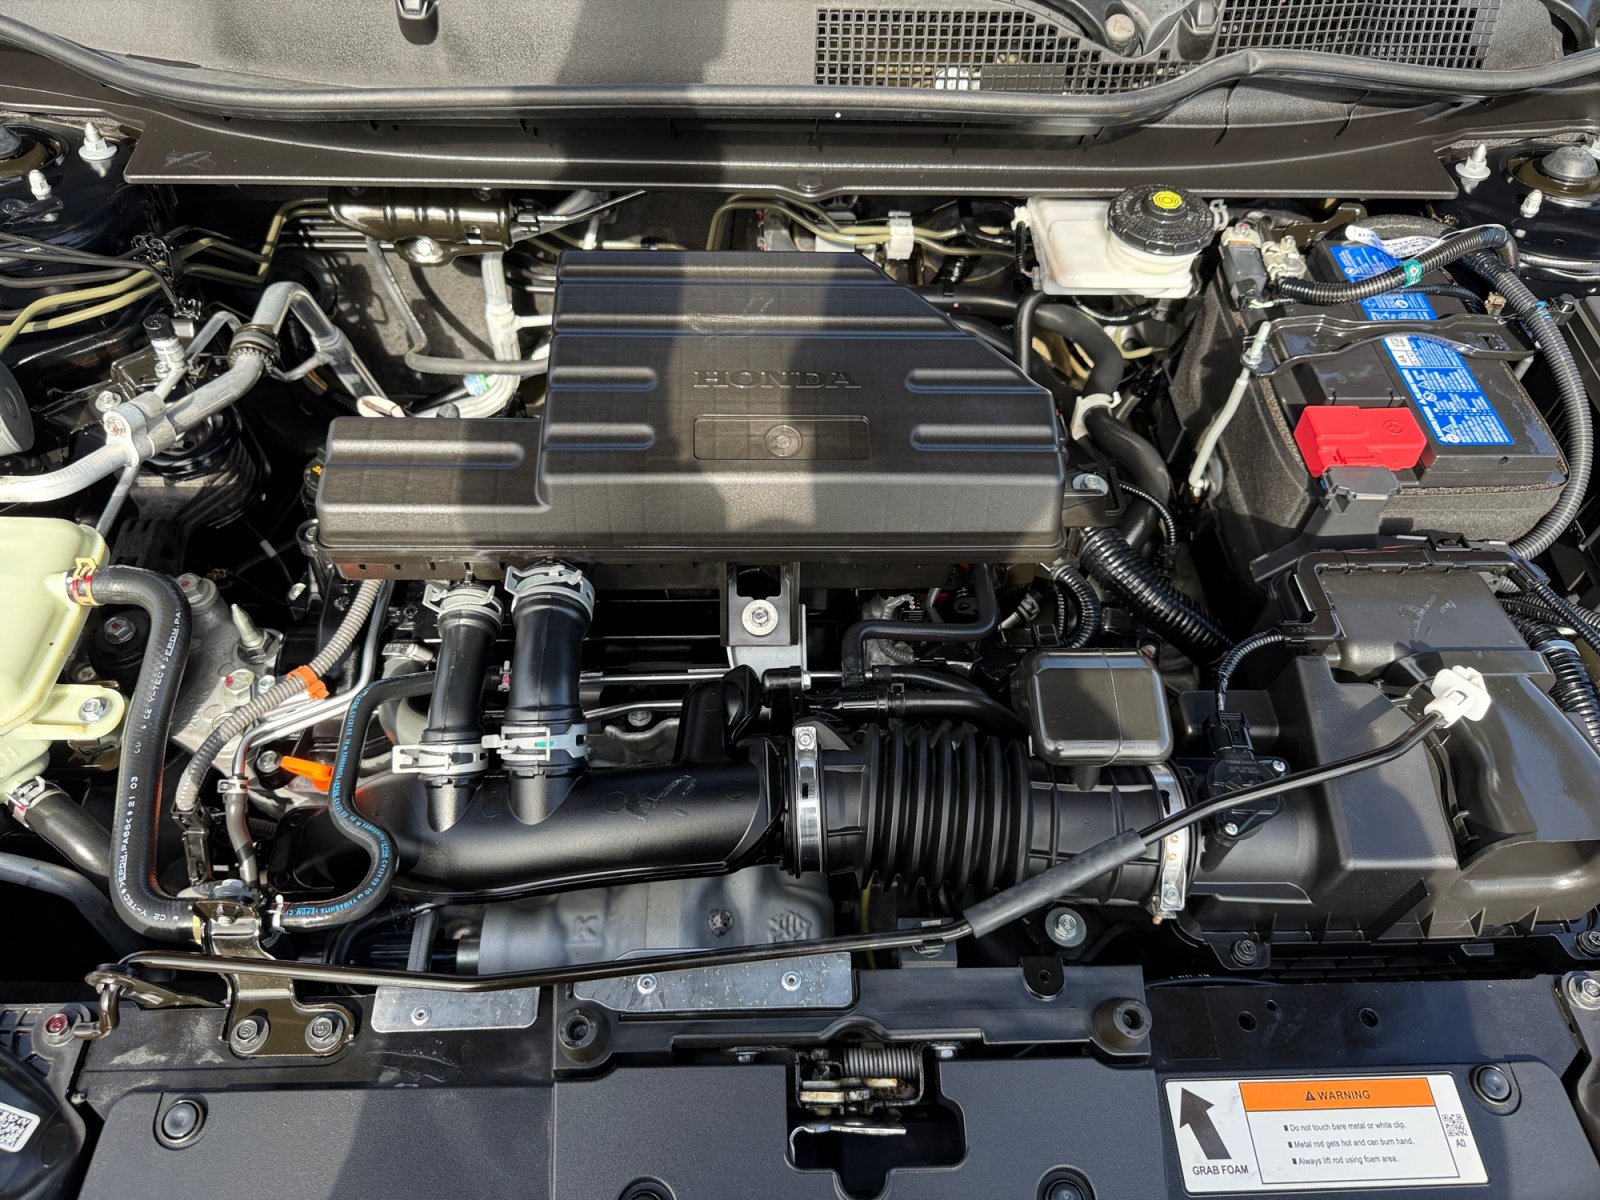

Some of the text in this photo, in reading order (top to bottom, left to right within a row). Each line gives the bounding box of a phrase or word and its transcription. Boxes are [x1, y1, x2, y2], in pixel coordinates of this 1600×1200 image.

[693, 369, 862, 389] HONDA
[320, 898, 358, 914] YAMASHITA
[1317, 1090, 1371, 1100] WARNING
[1290, 1121, 1407, 1132] Do not touch bare metal or white clip.
[1294, 1140, 1312, 1149] Metal
[1313, 1140, 1325, 1148] rod
[1326, 1140, 1340, 1149] gets
[1341, 1139, 1353, 1147] hot
[1354, 1138, 1366, 1147] and
[1380, 1137, 1395, 1145] burn
[1396, 1137, 1415, 1145] hand.
[1299, 1155, 1399, 1167] Always lift rod using foam area.
[1192, 1164, 1249, 1176] GRAB FOAM
